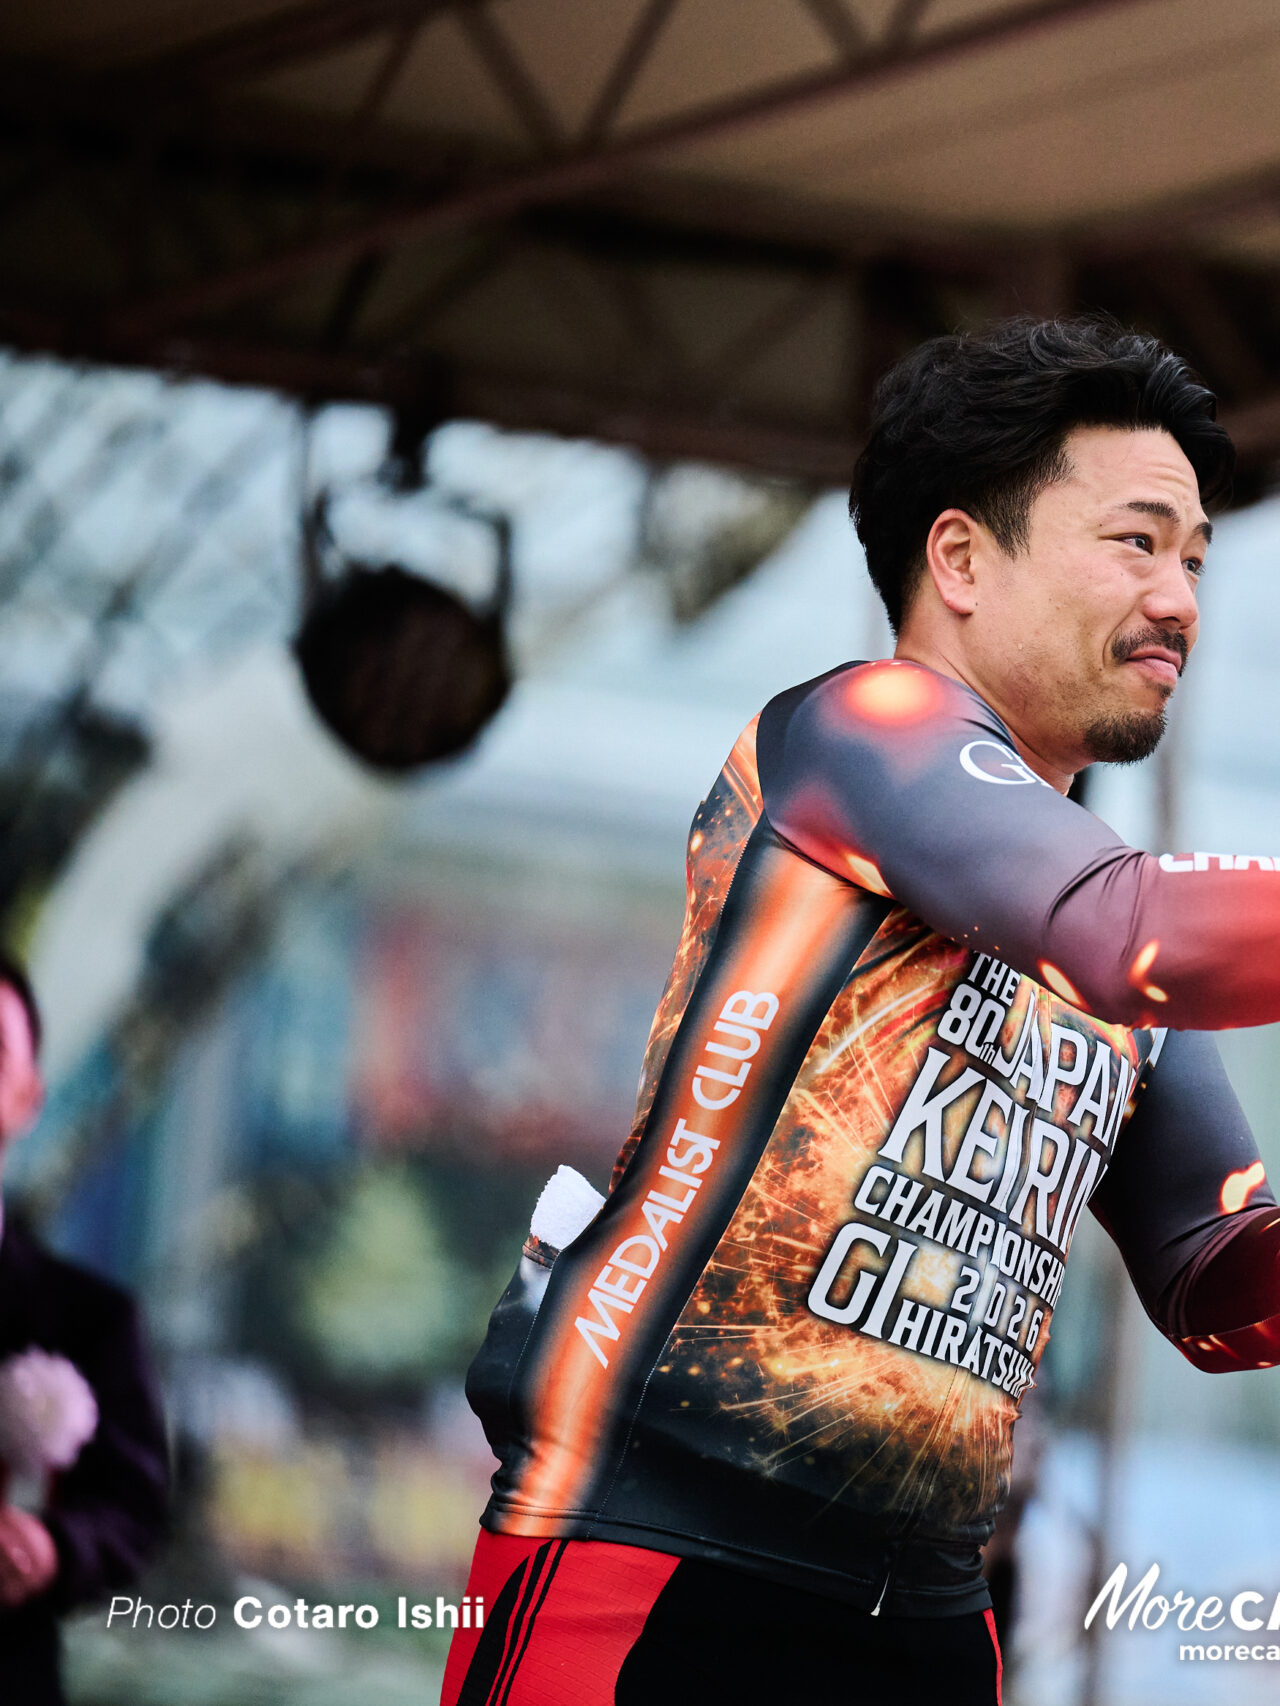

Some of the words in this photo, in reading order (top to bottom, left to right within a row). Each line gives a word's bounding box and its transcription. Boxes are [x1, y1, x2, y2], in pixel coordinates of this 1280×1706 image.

[967, 950, 1021, 1007] THE
[878, 1046, 1109, 1255] KEIRIN
[991, 990, 1137, 1156] JAPAN
[574, 1118, 721, 1370] MEDALIST
[692, 989, 780, 1111] CLUB
[854, 1166, 1066, 1311] CHAMPIONSHI
[951, 1266, 1044, 1353] 2026
